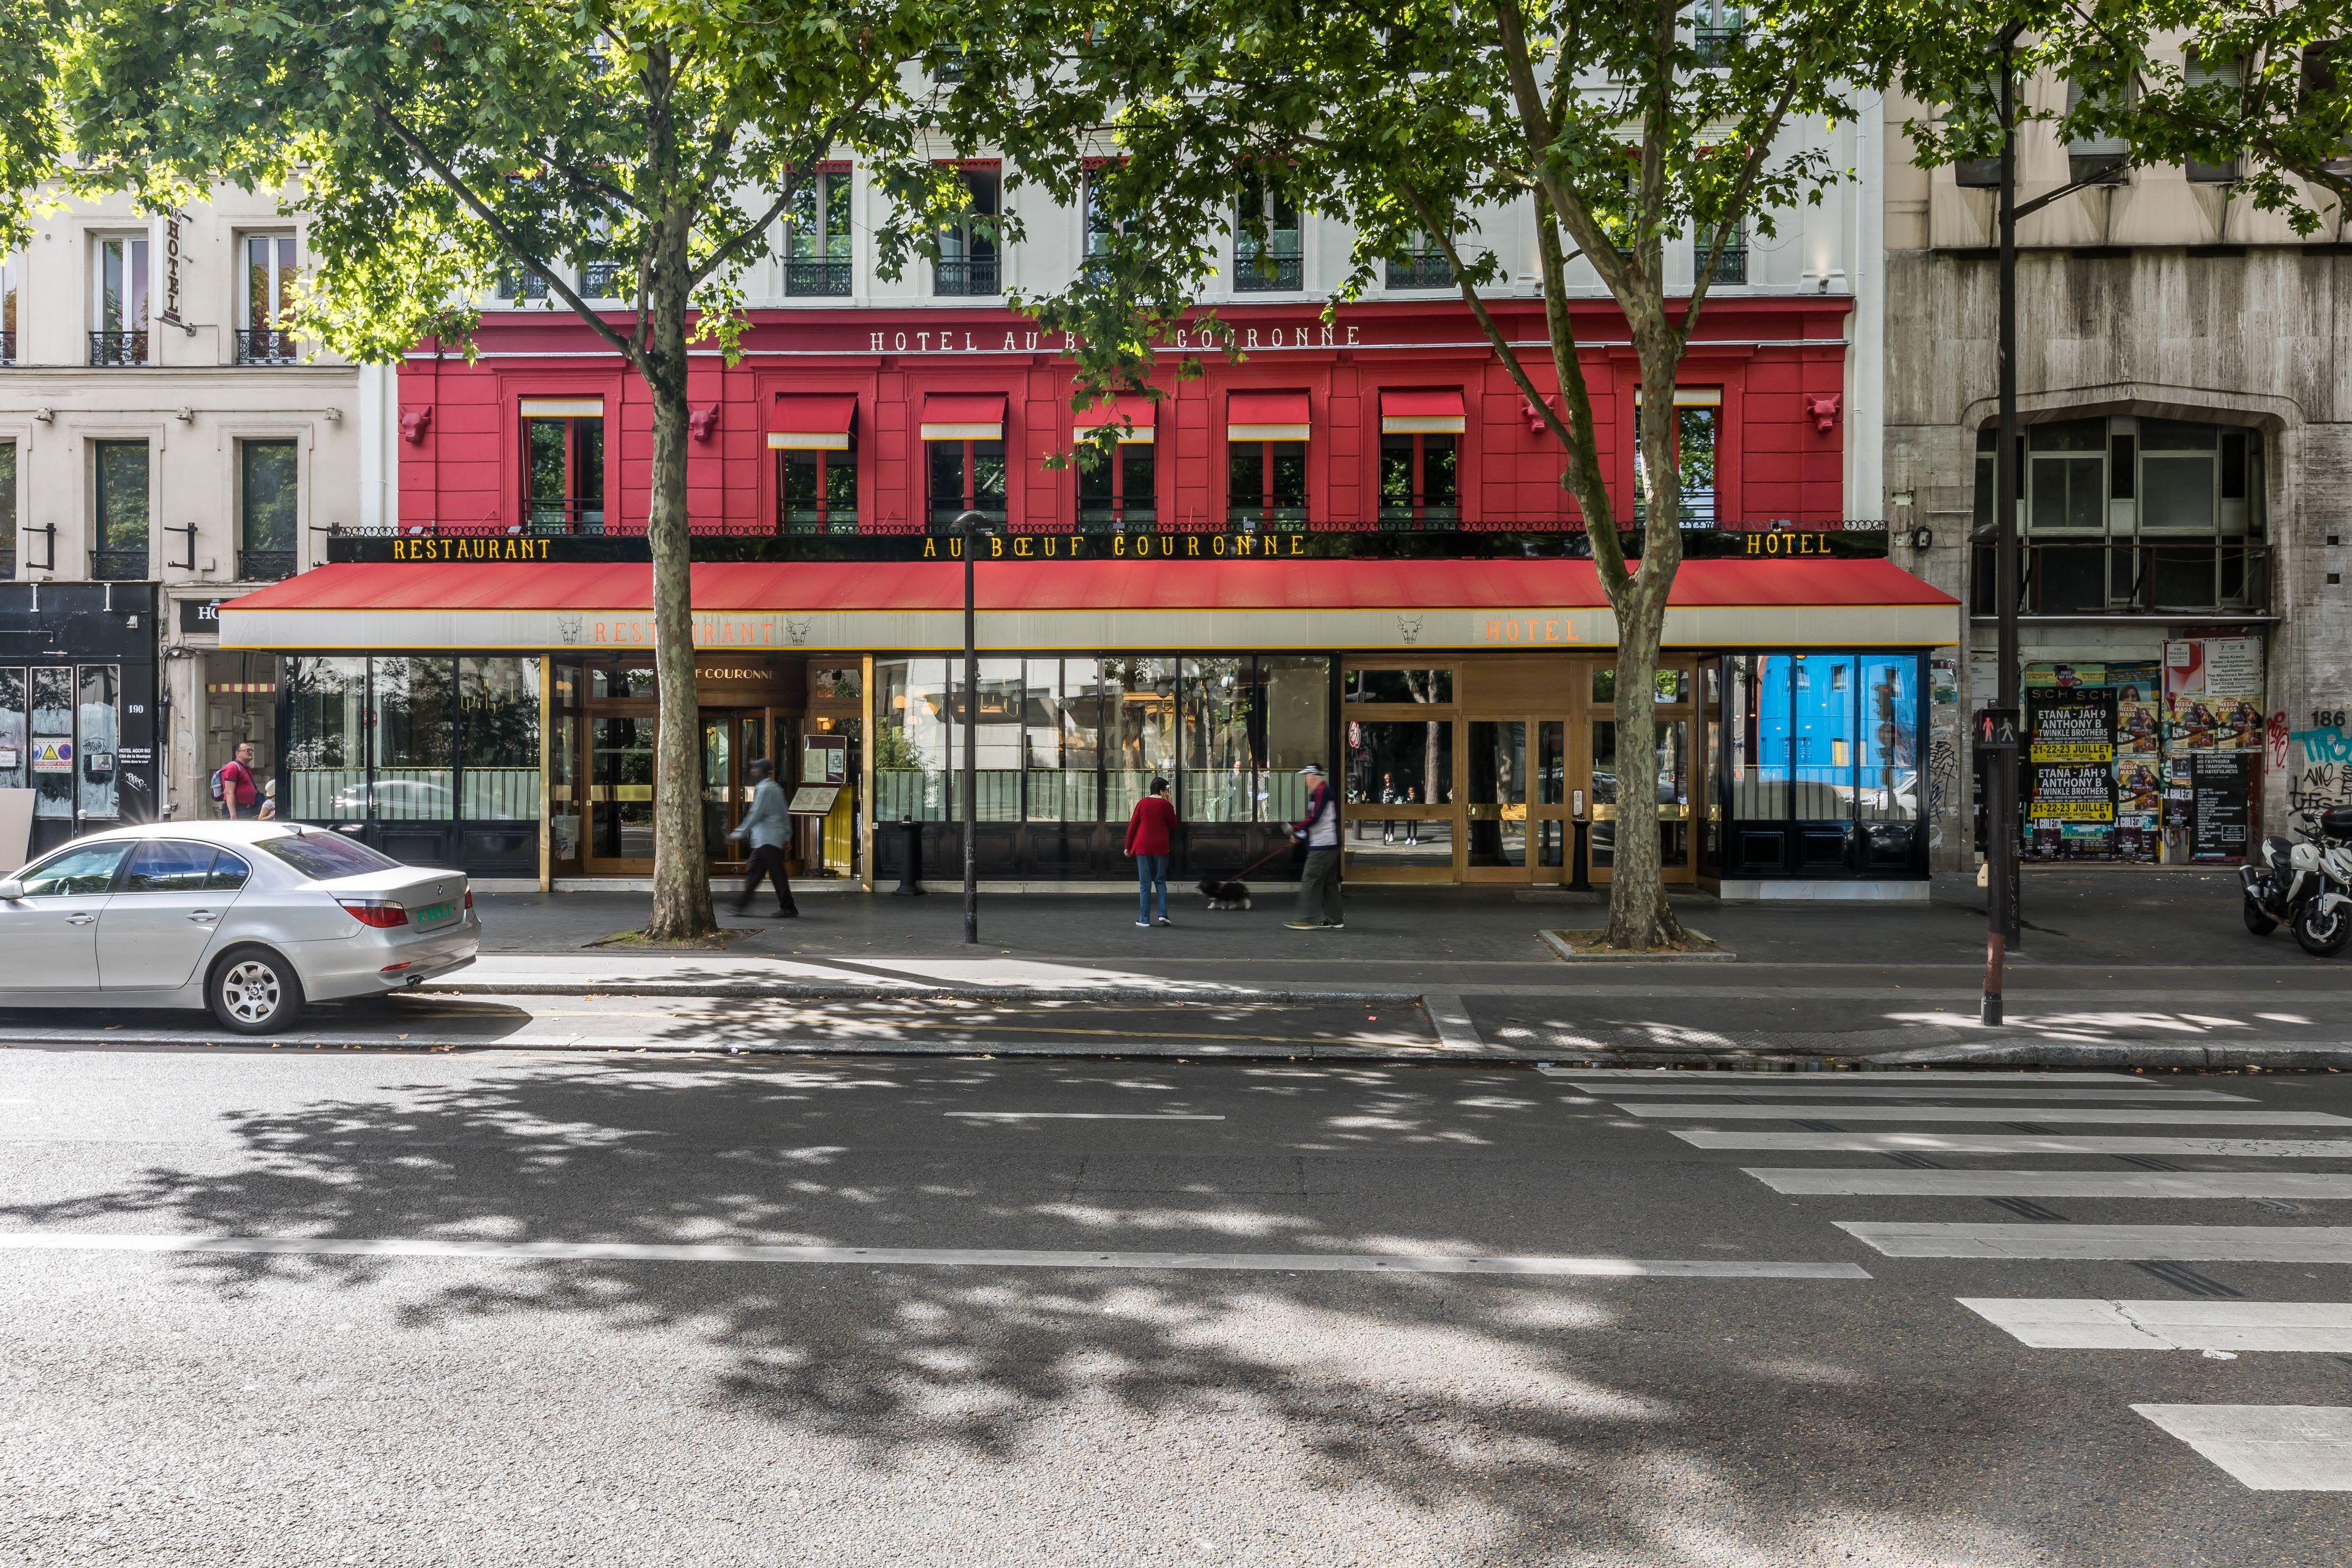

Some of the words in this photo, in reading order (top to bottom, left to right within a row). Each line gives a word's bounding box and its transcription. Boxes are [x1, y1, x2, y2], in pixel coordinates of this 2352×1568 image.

[167, 220, 179, 313] HOTEL
[870, 331, 977, 351] HOTEL
[1003, 331, 1038, 350] AU
[923, 538, 962, 557] AU
[991, 537, 1084, 557] BŒUF
[1114, 535, 1303, 556] COURONNE
[1747, 533, 1831, 554] HOTEL
[394, 539, 550, 559] RESTAURANT
[198, 606, 219, 619] HO
[595, 622, 773, 644] RESTRANT
[1486, 619, 1580, 641] HOTEL
[2032, 689, 2068, 698] SCH
[2076, 690, 2112, 700] SCH
[129, 705, 143, 714] 190
[2038, 710, 2070, 719] ETANA
[2078, 710, 2097, 718] JAH
[2100, 710, 2106, 718] 9
[2311, 710, 2346, 727] 186
[2042, 719, 2092, 729] ANTHONY
[2095, 719, 2101, 728] B
[2071, 728, 2108, 737] BROTHERS
[2034, 745, 2070, 754] 21-22-23
[2073, 744, 2110, 753] JUILLET
[2038, 769, 2070, 778] ETANA
[2079, 769, 2098, 777] JAH
[2100, 769, 2106, 777] 9
[2042, 778, 2092, 787] ANTHONY
[2163, 789, 2169, 799] J.
[2170, 789, 2185, 799] COLE
[2033, 804, 2070, 812] 21-22-23
[2073, 804, 2110, 812] JUILLET
[2033, 818, 2039, 829] J.
[2040, 818, 2054, 829] COLE
[2114, 817, 2120, 827] J.
[2120, 817, 2135, 827] COLE
